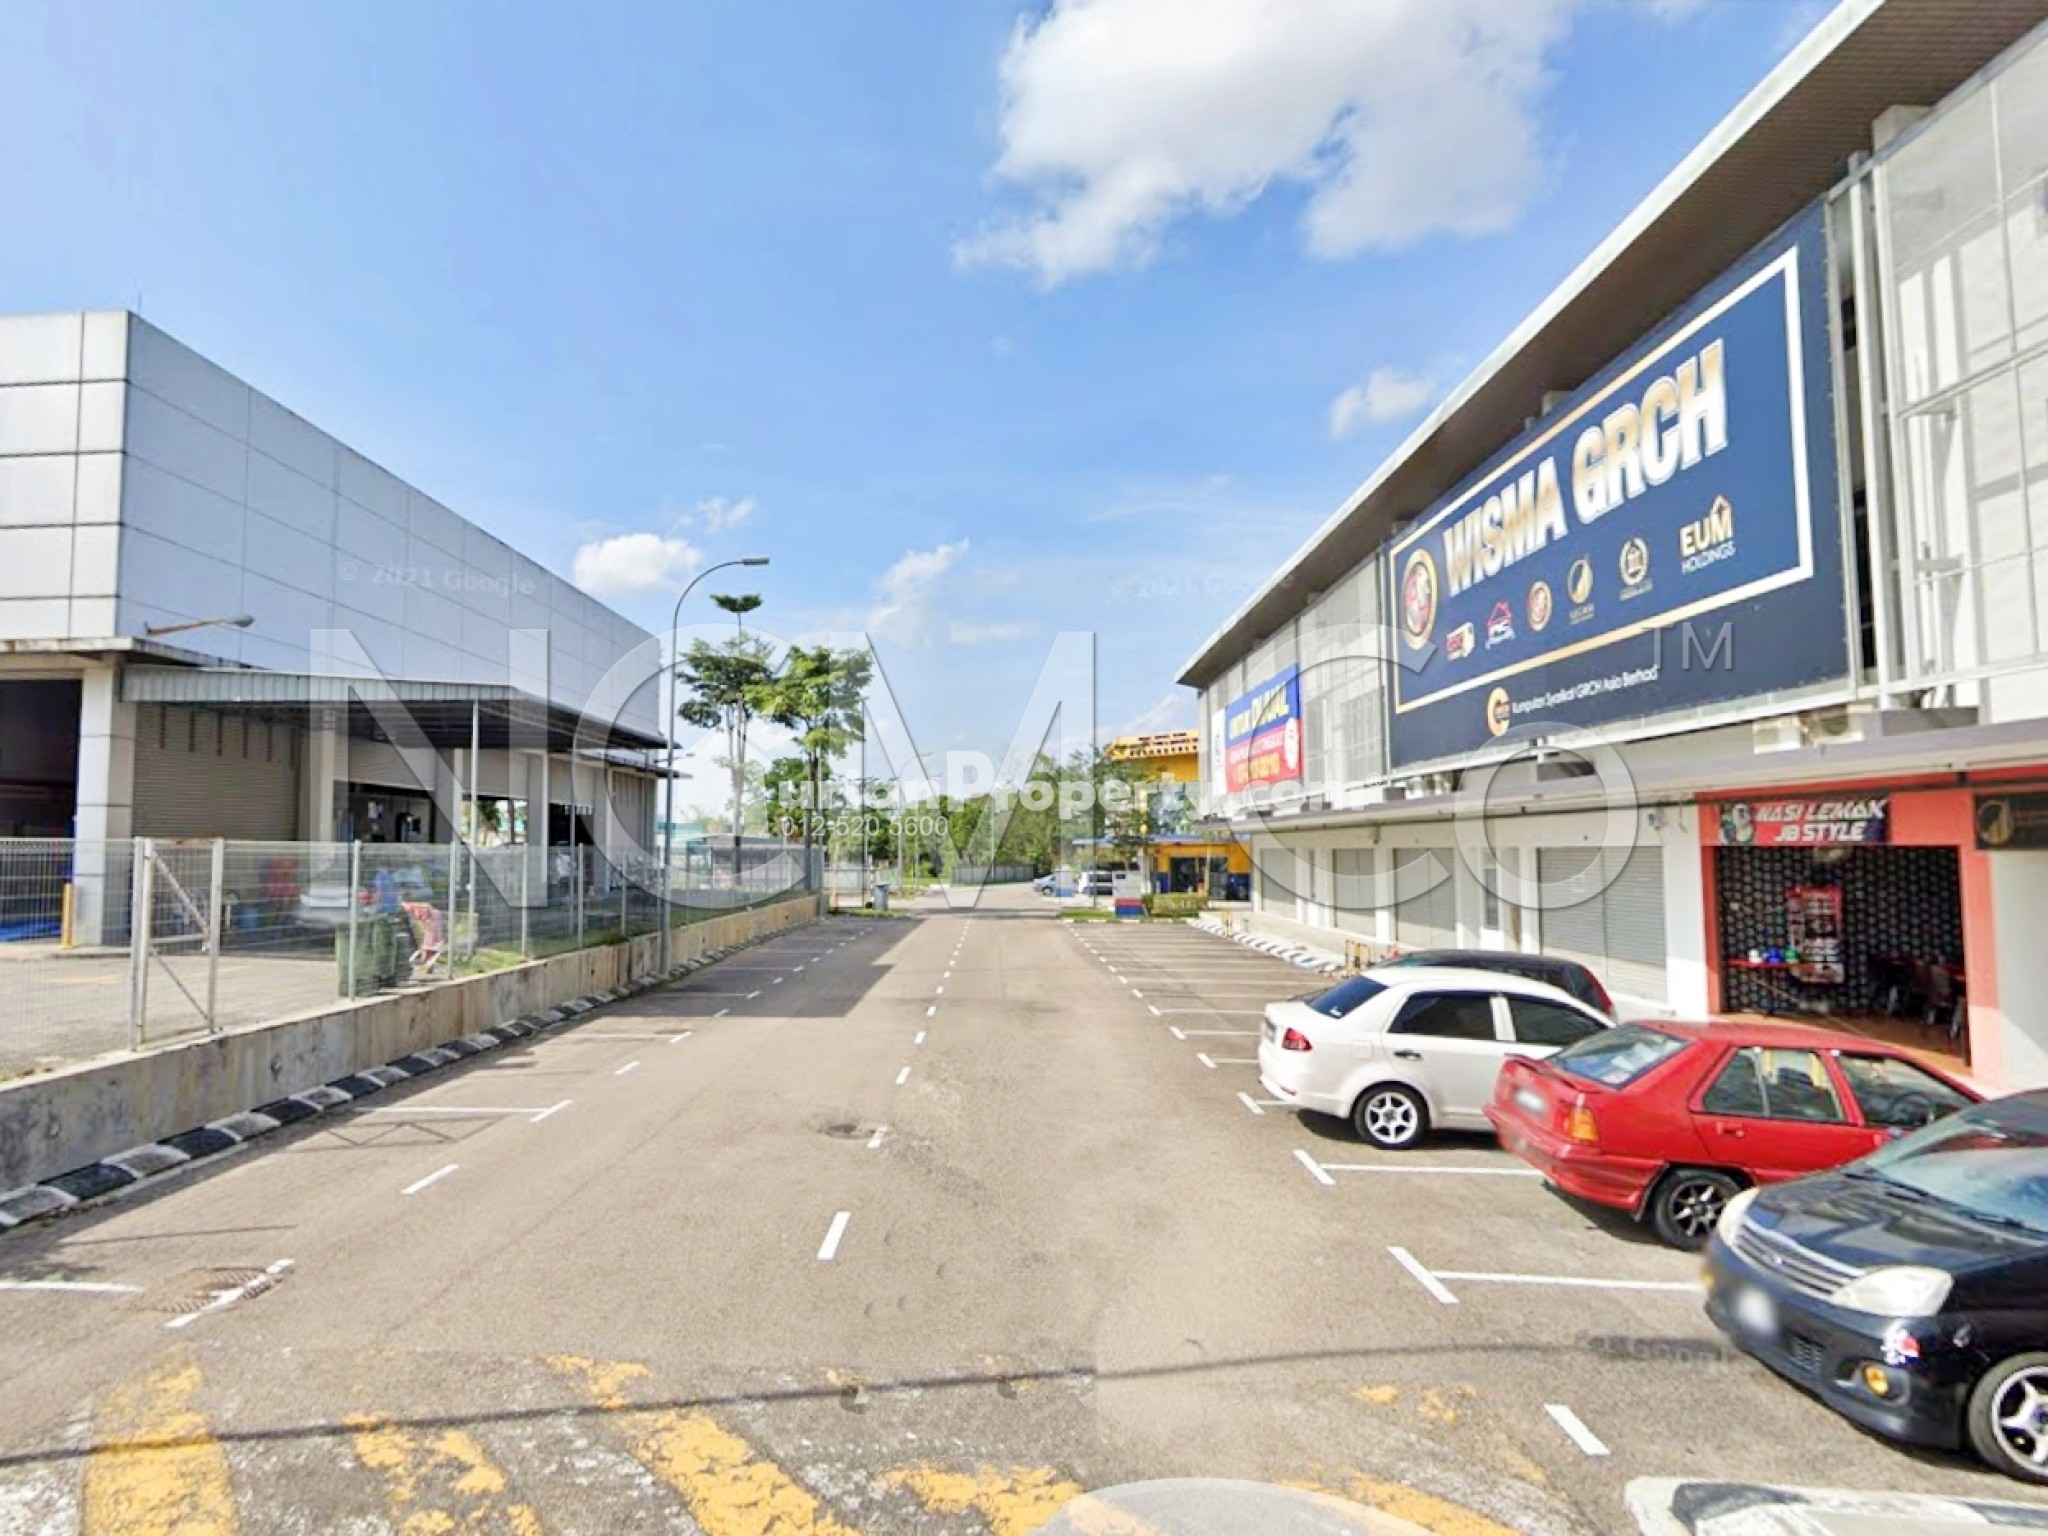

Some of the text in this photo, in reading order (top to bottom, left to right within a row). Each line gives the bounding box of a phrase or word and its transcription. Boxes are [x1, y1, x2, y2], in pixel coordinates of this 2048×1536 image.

[1443, 338, 1728, 597] WISMA GRCH
[1680, 495, 1733, 557] EUM
[1681, 541, 1736, 574] HOLDINGS
[1756, 799, 1888, 822] NASI LEMAK
[1774, 822, 1867, 842] JB STYLE
